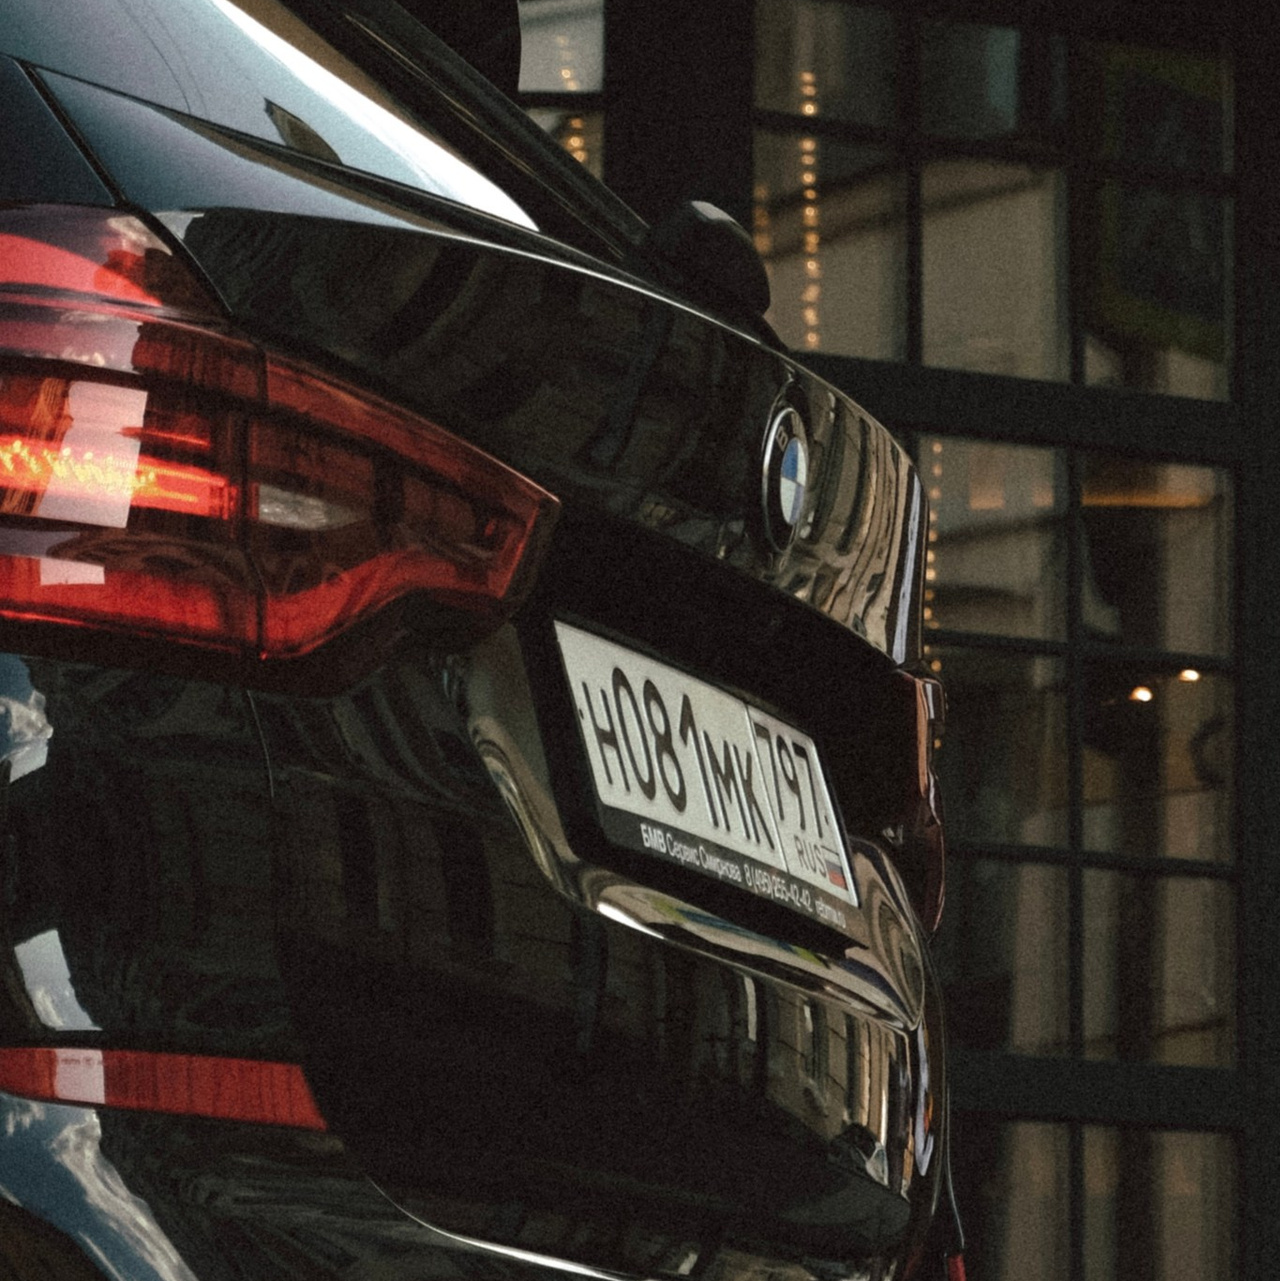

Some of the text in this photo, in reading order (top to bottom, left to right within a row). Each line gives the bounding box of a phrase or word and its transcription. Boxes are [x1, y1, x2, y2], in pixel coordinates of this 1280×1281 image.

[752, 720, 823, 839] 797
[640, 823, 667, 853] БМВ
[793, 835, 827, 878] RUS
